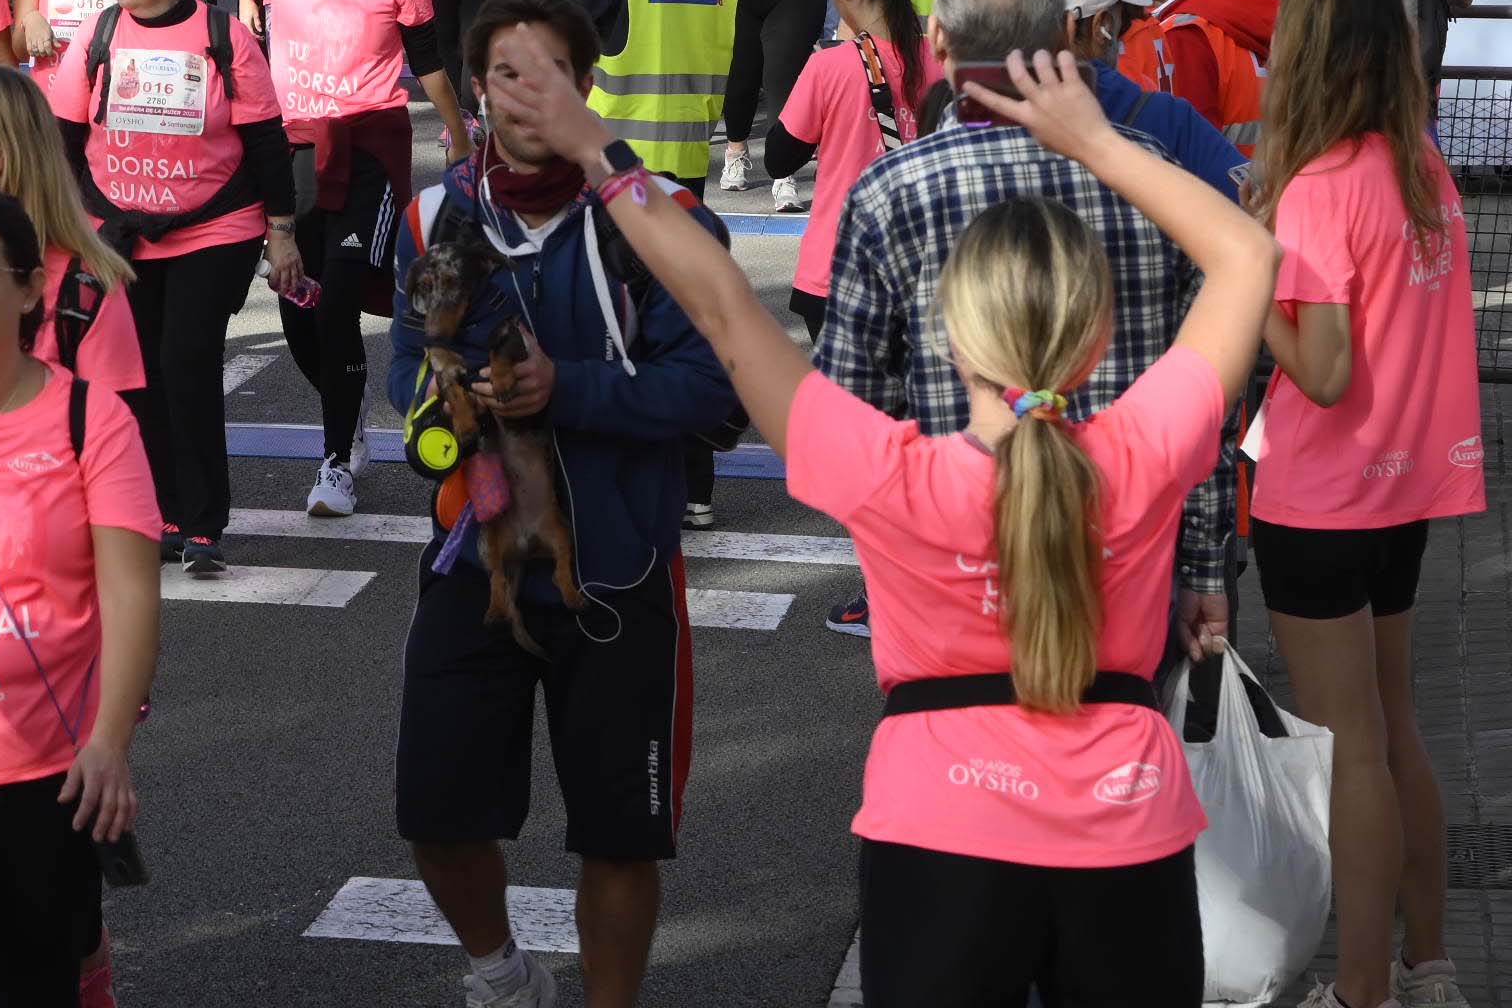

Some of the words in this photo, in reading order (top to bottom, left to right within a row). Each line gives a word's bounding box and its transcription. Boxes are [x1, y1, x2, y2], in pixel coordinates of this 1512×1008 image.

[287, 39, 308, 61] TU
[142, 81, 175, 95] 016
[146, 97, 167, 106] 2780
[285, 91, 341, 115] SUMA
[115, 118, 144, 126] OYSHO
[106, 154, 200, 179] DORSAL
[109, 180, 177, 206] SUMA
[340, 239, 363, 249] adidas
[649, 739, 659, 816] sportika
[948, 764, 1039, 801] OYSHO
